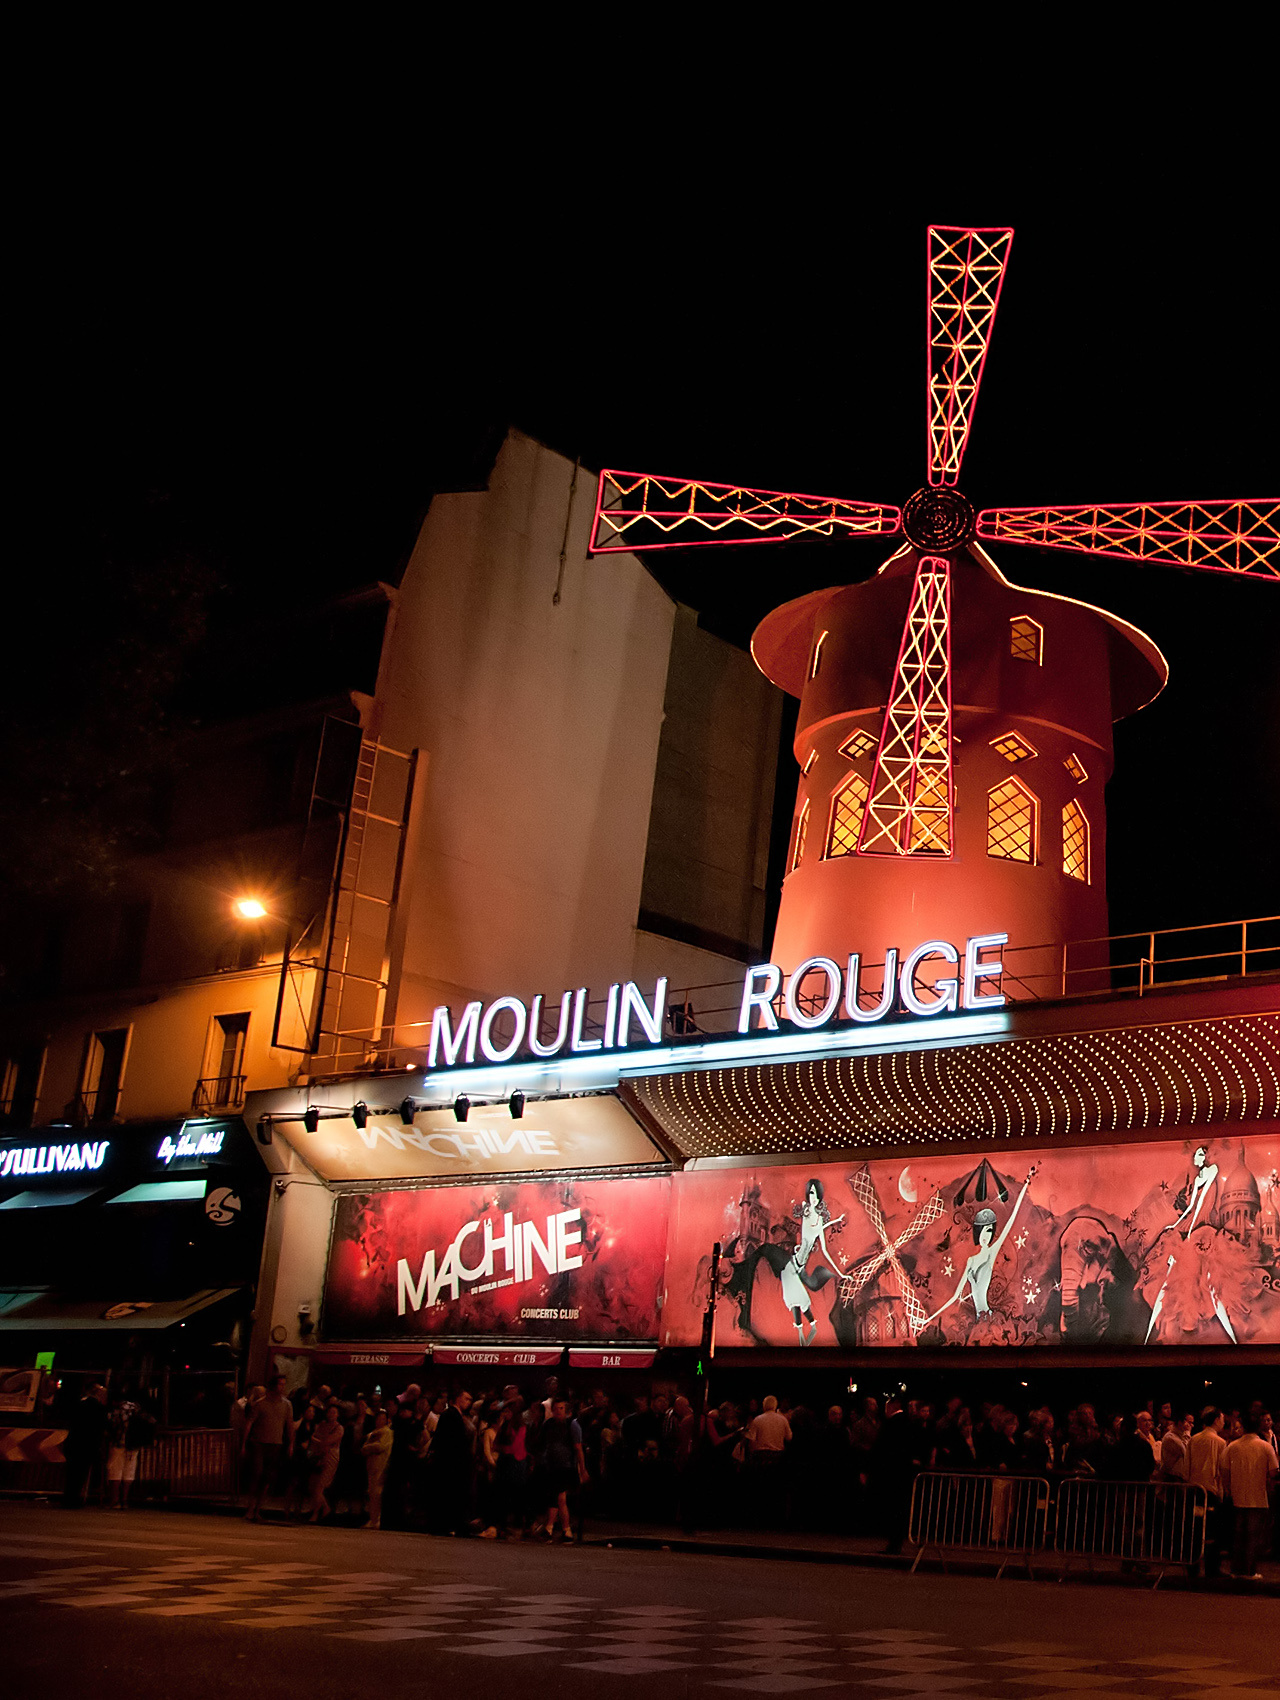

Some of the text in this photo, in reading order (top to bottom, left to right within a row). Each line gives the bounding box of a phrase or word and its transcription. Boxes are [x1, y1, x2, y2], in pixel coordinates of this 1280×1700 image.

[428, 933, 1009, 1067] MOULIN ROUGE
[0, 1141, 110, 1176] 'SULLIVANS
[397, 1207, 584, 1317] MACHINE
[520, 1307, 580, 1320] CONCERTS CLUB
[350, 1354, 390, 1365] TERRASSE
[455, 1352, 537, 1365] CONCERTS CLUB
[601, 1355, 622, 1367] BAR
